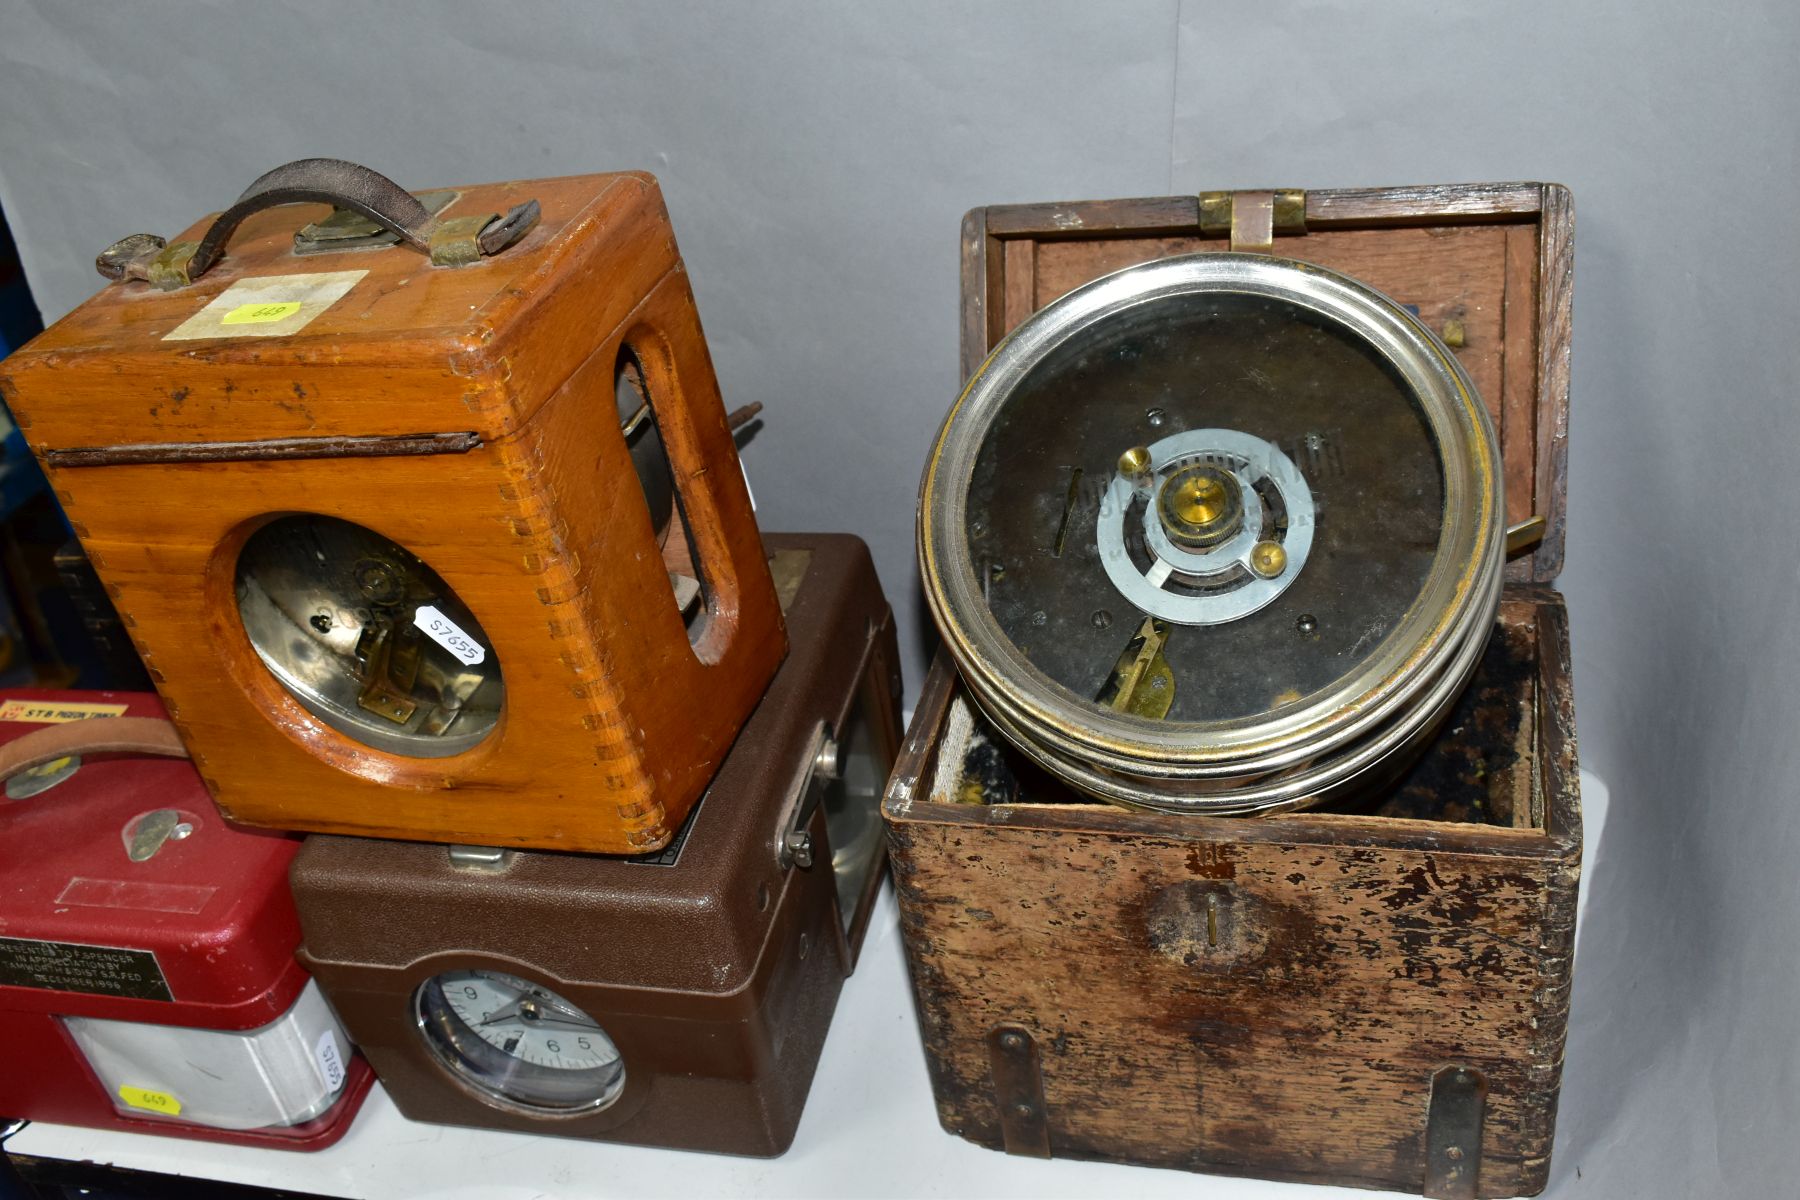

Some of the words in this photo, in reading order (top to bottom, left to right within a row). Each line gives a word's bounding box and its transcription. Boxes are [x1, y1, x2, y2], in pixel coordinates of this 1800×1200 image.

[430, 619, 479, 660] S7655
[463, 986, 478, 1000] 9
[546, 1039, 561, 1053] 6
[578, 1036, 591, 1050] 5
